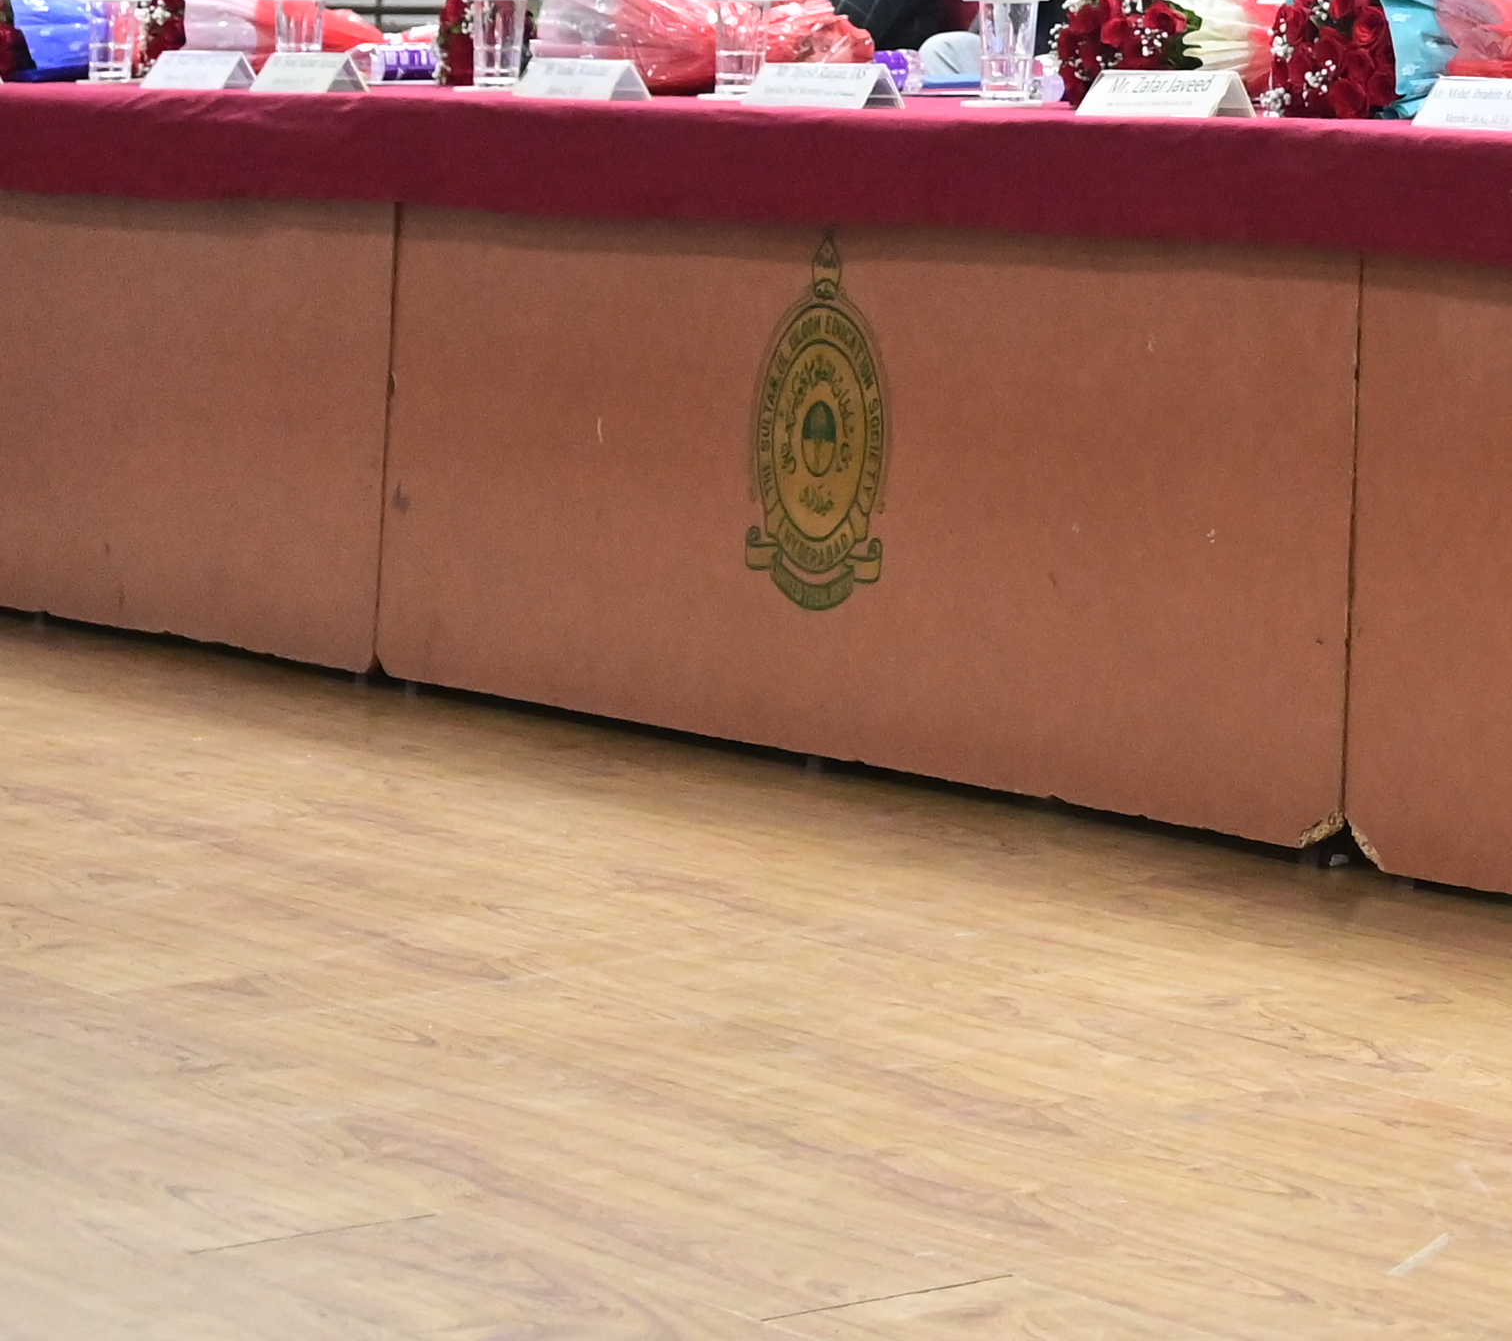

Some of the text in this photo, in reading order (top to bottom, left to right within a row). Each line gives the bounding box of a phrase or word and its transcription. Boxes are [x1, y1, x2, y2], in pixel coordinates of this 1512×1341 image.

[1107, 74, 1216, 94] Mr. Zafar Javeed
